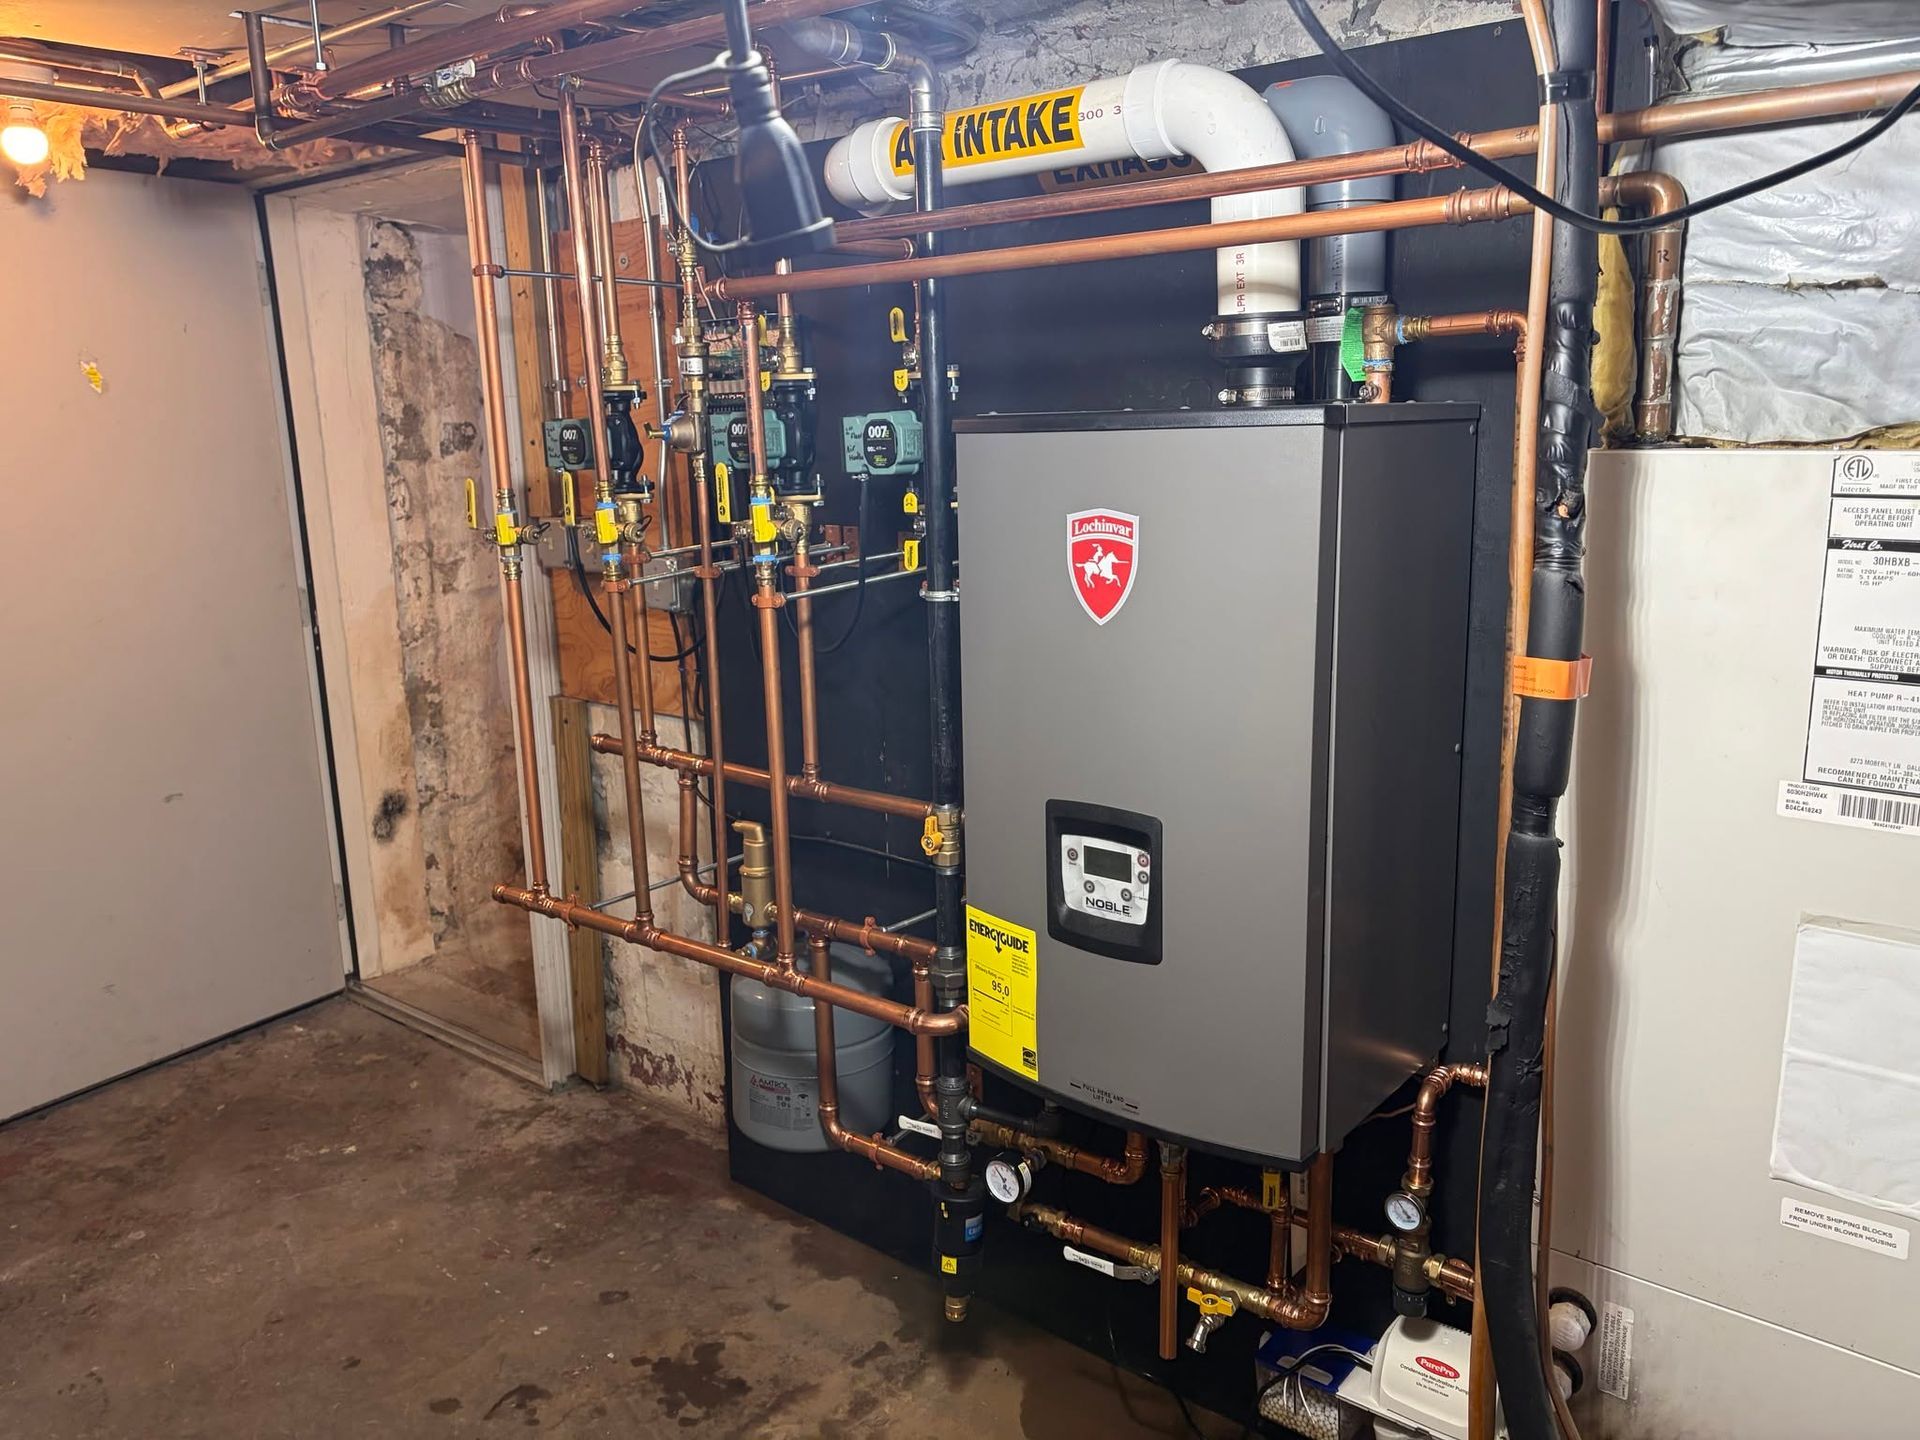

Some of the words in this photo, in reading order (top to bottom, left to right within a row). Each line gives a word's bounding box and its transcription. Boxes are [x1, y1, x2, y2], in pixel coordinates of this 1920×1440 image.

[1078, 108, 1104, 122] 300
[954, 95, 1075, 158] INTAKE
[1236, 272, 1245, 290] EXT
[562, 429, 577, 440] 007
[1847, 459, 1870, 479] ETL
[1840, 485, 1872, 493] Intertek
[1843, 506, 1869, 515] ACCESS
[1871, 507, 1893, 515] PANEL
[1895, 508, 1915, 516] MUST
[1887, 514, 1914, 522] BEFORE
[1073, 518, 1132, 537] Lochinvar
[1854, 520, 1894, 528] OPERATING
[1896, 521, 1912, 529] UNIT
[1841, 540, 1866, 550] First
[1854, 625, 1884, 633] MAXIMUM
[1885, 627, 1905, 635] WATER
[1823, 646, 1859, 655] WARNING:
[1861, 648, 1878, 656] RISK
[1827, 652, 1837, 660] OR
[1840, 653, 1865, 662] DEATH:
[1867, 655, 1913, 666] DISCONNECT
[1869, 663, 1904, 672] SUPPLIES
[1847, 689, 1868, 698] HEAT
[1870, 691, 1894, 700] PUMP
[1841, 699, 1848, 707] TO
[1849, 701, 1885, 711] INSTALLATION
[1864, 758, 1892, 768] MOBERLY
[1817, 766, 1878, 780] RECOMMENDED
[1837, 775, 1853, 784] CAN
[1868, 780, 1896, 789] FOUND
[1085, 896, 1131, 915] NOBLE
[969, 918, 1029, 954] ENERGYGUIDE
[992, 979, 1010, 997] 95.0
[1082, 1083, 1096, 1093] PULL
[1097, 1088, 1112, 1099] HERE
[1113, 1095, 1125, 1103] AND
[1093, 1093, 1104, 1102] LIFT
[1794, 1206, 1824, 1220] REMOVE
[1826, 1215, 1861, 1230] SHIPPING
[1862, 1225, 1894, 1239] BLOCKS
[1788, 1214, 1808, 1224] FROM
[1809, 1220, 1833, 1231] UNDER
[1834, 1226, 1864, 1239] BLOWER
[1865, 1235, 1897, 1249] HOUSING
[1420, 1358, 1455, 1378] PurePro
[1400, 1363, 1429, 1378] Condensate
[1429, 1375, 1455, 1389] Neutralizer
